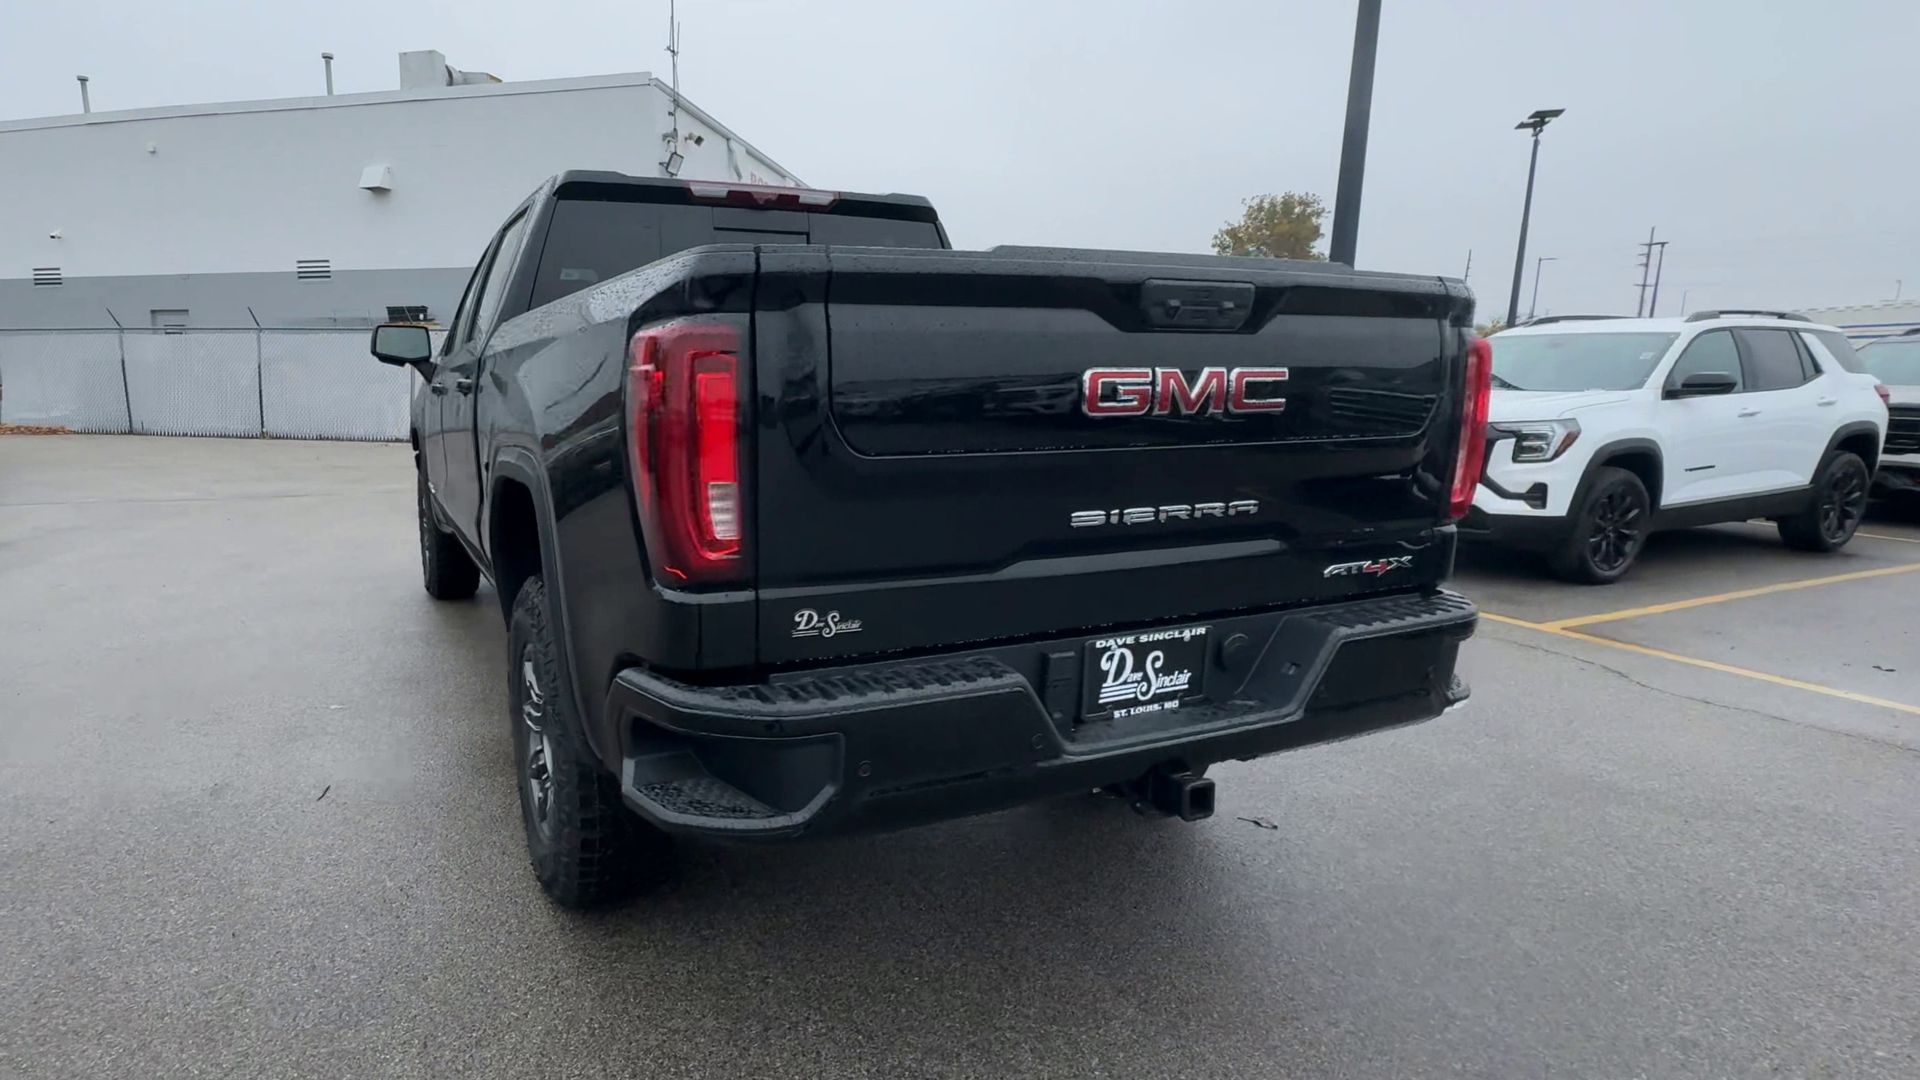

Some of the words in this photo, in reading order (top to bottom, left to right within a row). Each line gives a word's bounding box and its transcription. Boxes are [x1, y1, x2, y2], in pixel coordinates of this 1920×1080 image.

[1082, 367, 1289, 416] GMC
[1070, 500, 1259, 528] SIERRA
[1323, 555, 1413, 578] AT4X
[1095, 637, 1135, 648] DAVE
[1139, 627, 1206, 642] SINCLAIR
[1100, 647, 1144, 688] Dave
[1136, 650, 1192, 700] Sinclair
[1113, 709, 1128, 718] ST.
